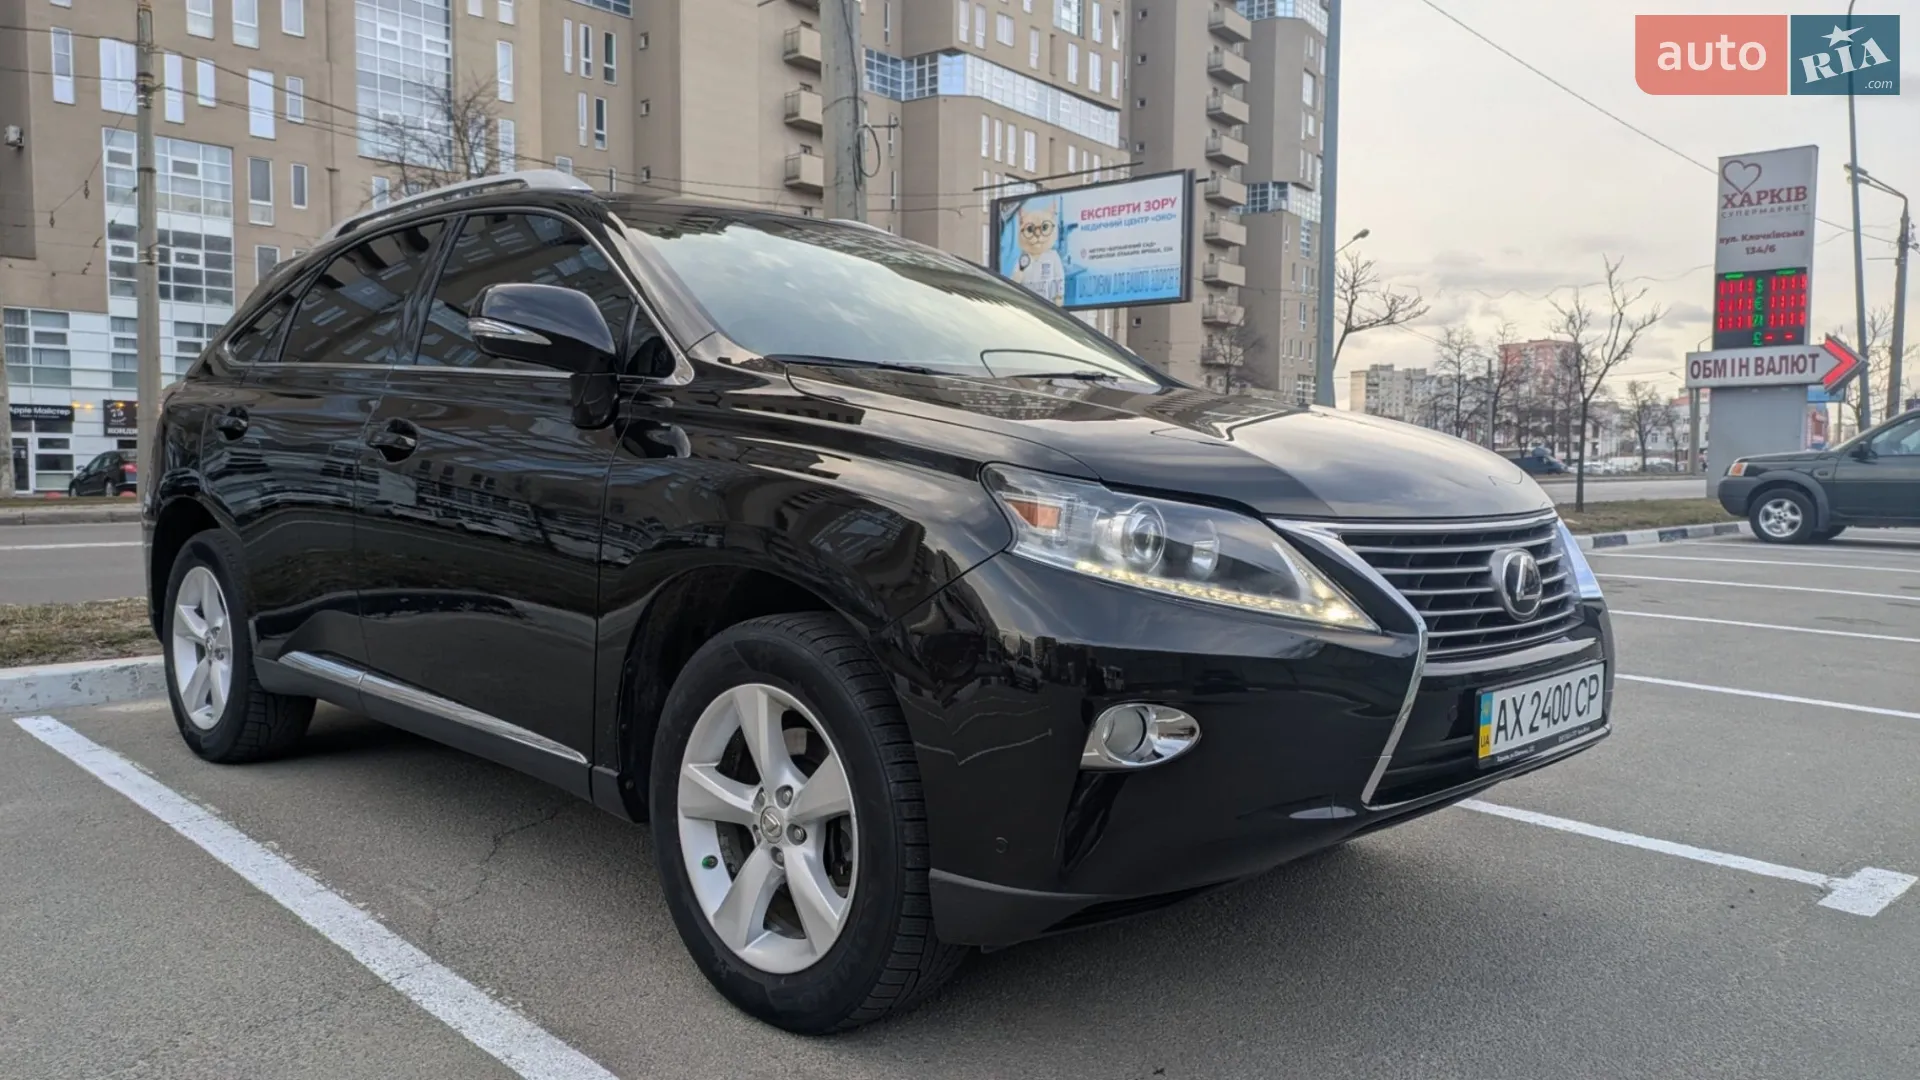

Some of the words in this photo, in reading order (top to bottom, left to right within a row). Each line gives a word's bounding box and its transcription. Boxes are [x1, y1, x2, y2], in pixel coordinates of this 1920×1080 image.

[1080, 202, 1141, 221] ЕКСПЕРТИ
[1144, 197, 1177, 212] ЗОРУ
[1721, 186, 1808, 209] ХАРКІВ
[1721, 204, 1809, 218] СУПЕРМАРКЕТ
[1080, 219, 1122, 231] МЕДИЧНИЙ
[1124, 216, 1150, 227] ЦЕНТР
[1690, 360, 1750, 379] ОБМІН
[1754, 354, 1820, 377] ВАЛЮТ
[1529, 681, 1573, 733] 2400
[1480, 734, 1490, 748] UA
